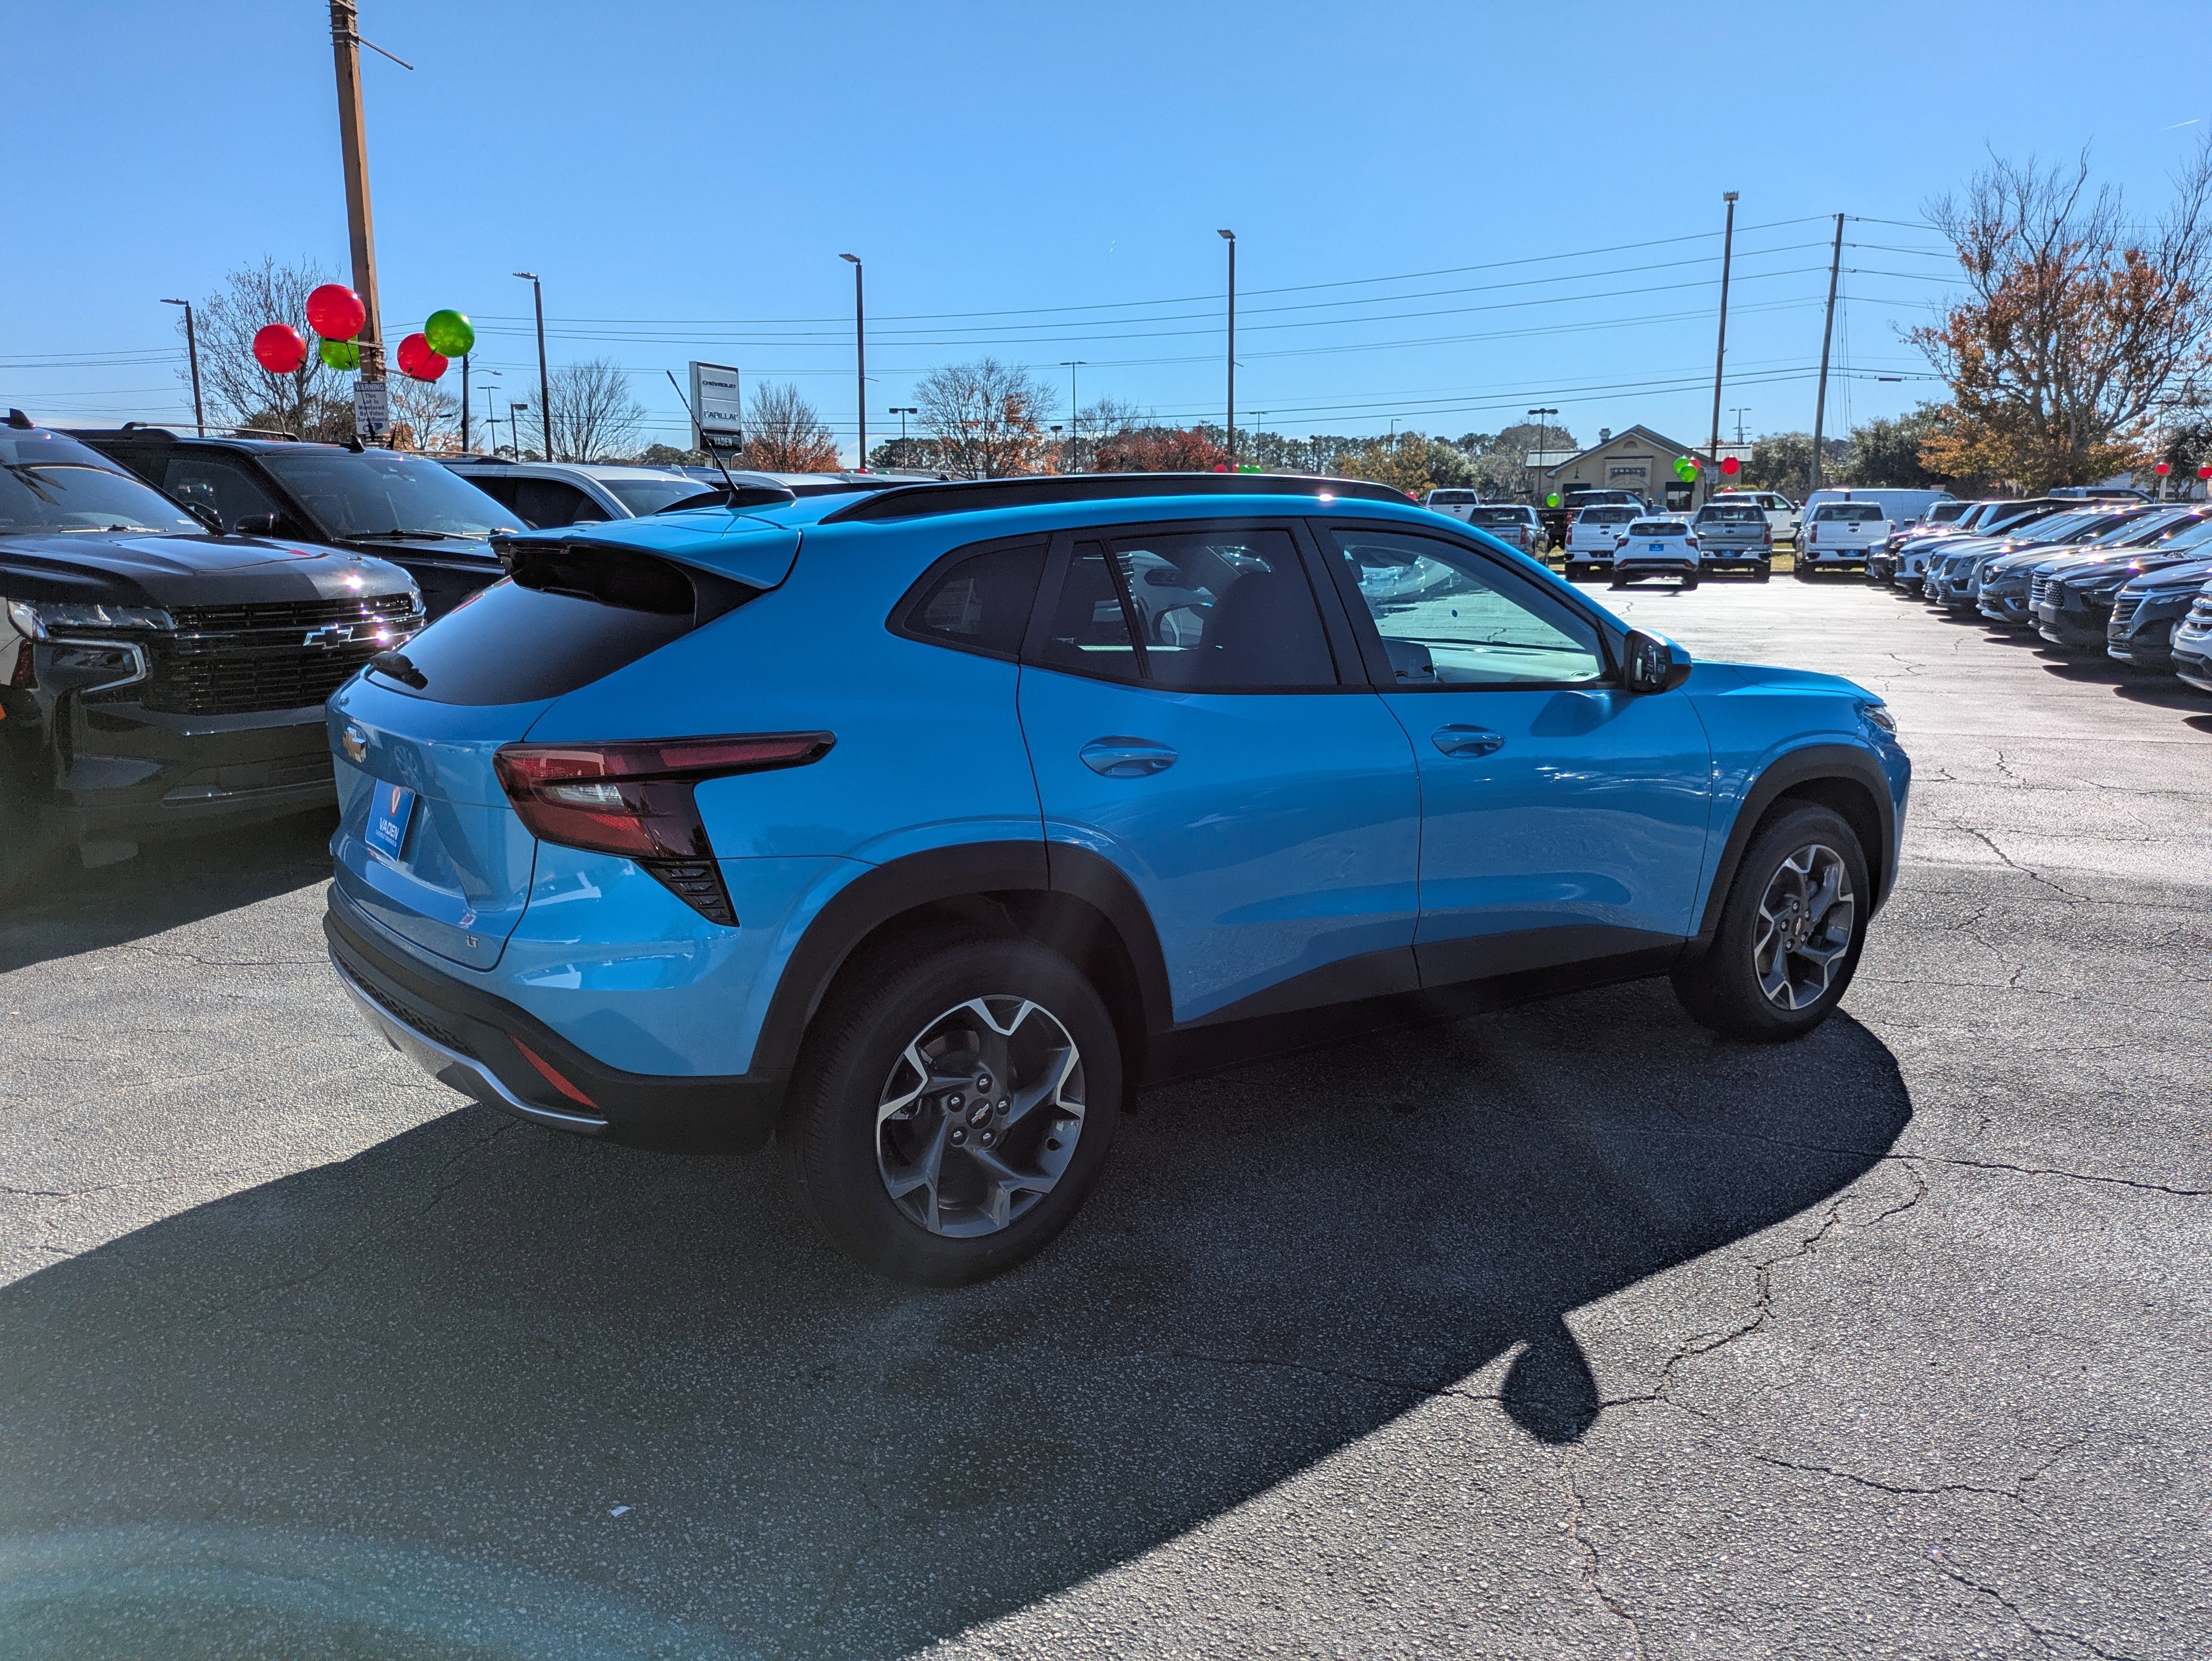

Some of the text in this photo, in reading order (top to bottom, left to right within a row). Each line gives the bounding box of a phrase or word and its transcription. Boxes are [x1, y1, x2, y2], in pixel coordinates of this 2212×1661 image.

[702, 380, 736, 388] CHEVROLET
[704, 410, 739, 420] CADILLAC
[714, 437, 732, 446] VADEN
[379, 817, 399, 840] VADEN
[466, 935, 480, 948] LT
